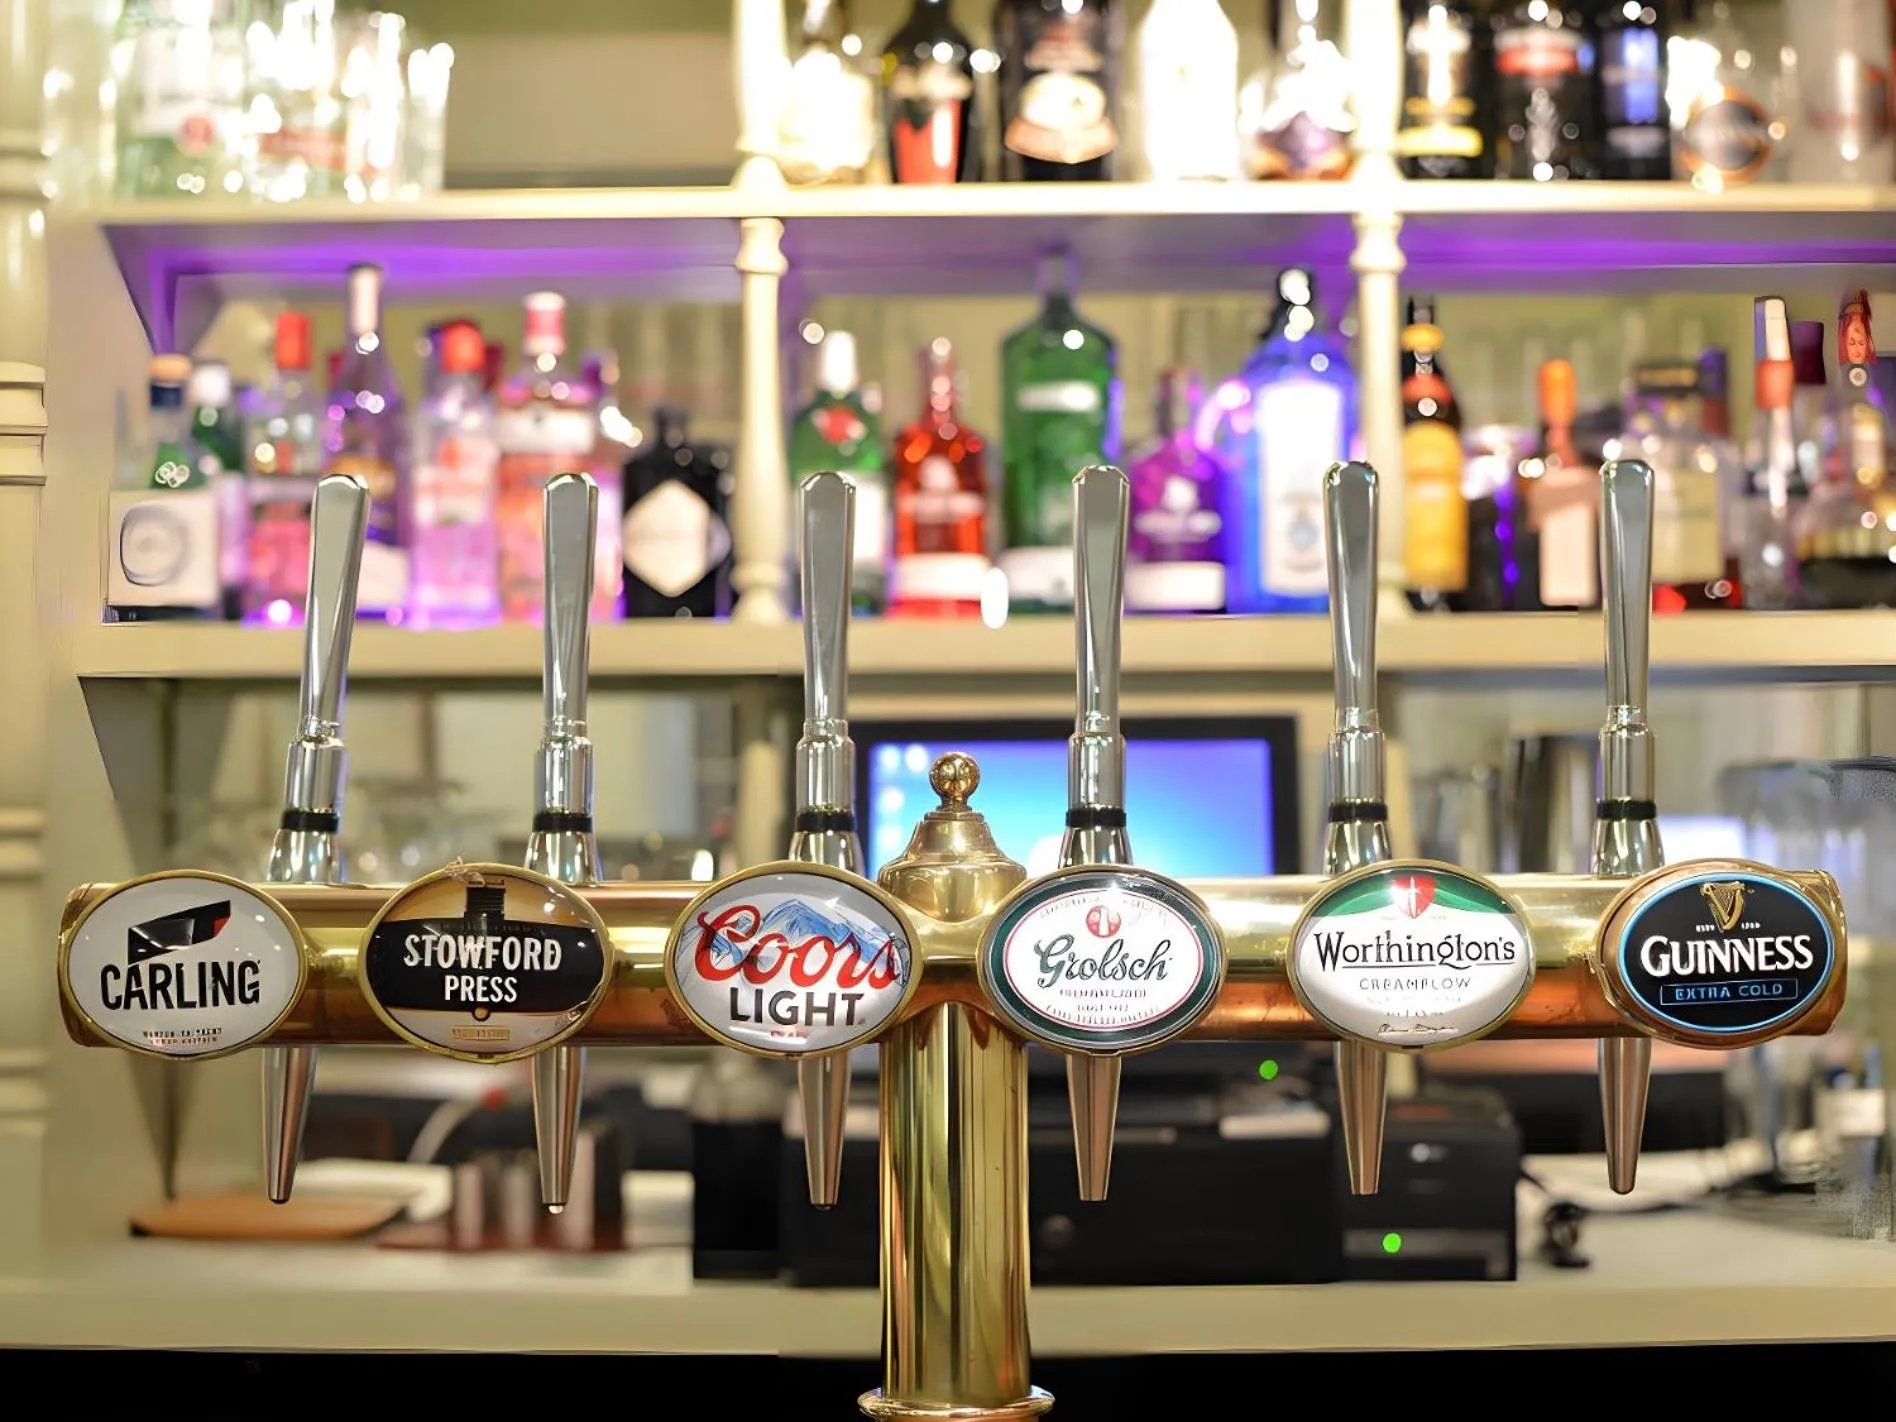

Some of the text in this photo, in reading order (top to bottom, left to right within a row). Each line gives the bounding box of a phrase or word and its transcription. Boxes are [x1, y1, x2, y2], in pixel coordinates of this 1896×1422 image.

[404, 934, 562, 971] STOWFORD
[695, 905, 899, 989] Coors
[1034, 934, 1169, 989] Grolsch
[1314, 930, 1516, 972] Worthington's
[1640, 935, 1814, 978] GUINNESS
[101, 960, 260, 1010] CARLING
[445, 975, 518, 1003] PRESS
[1675, 983, 1783, 1000] EXTRA COLD
[730, 987, 864, 1026] LIGHT
